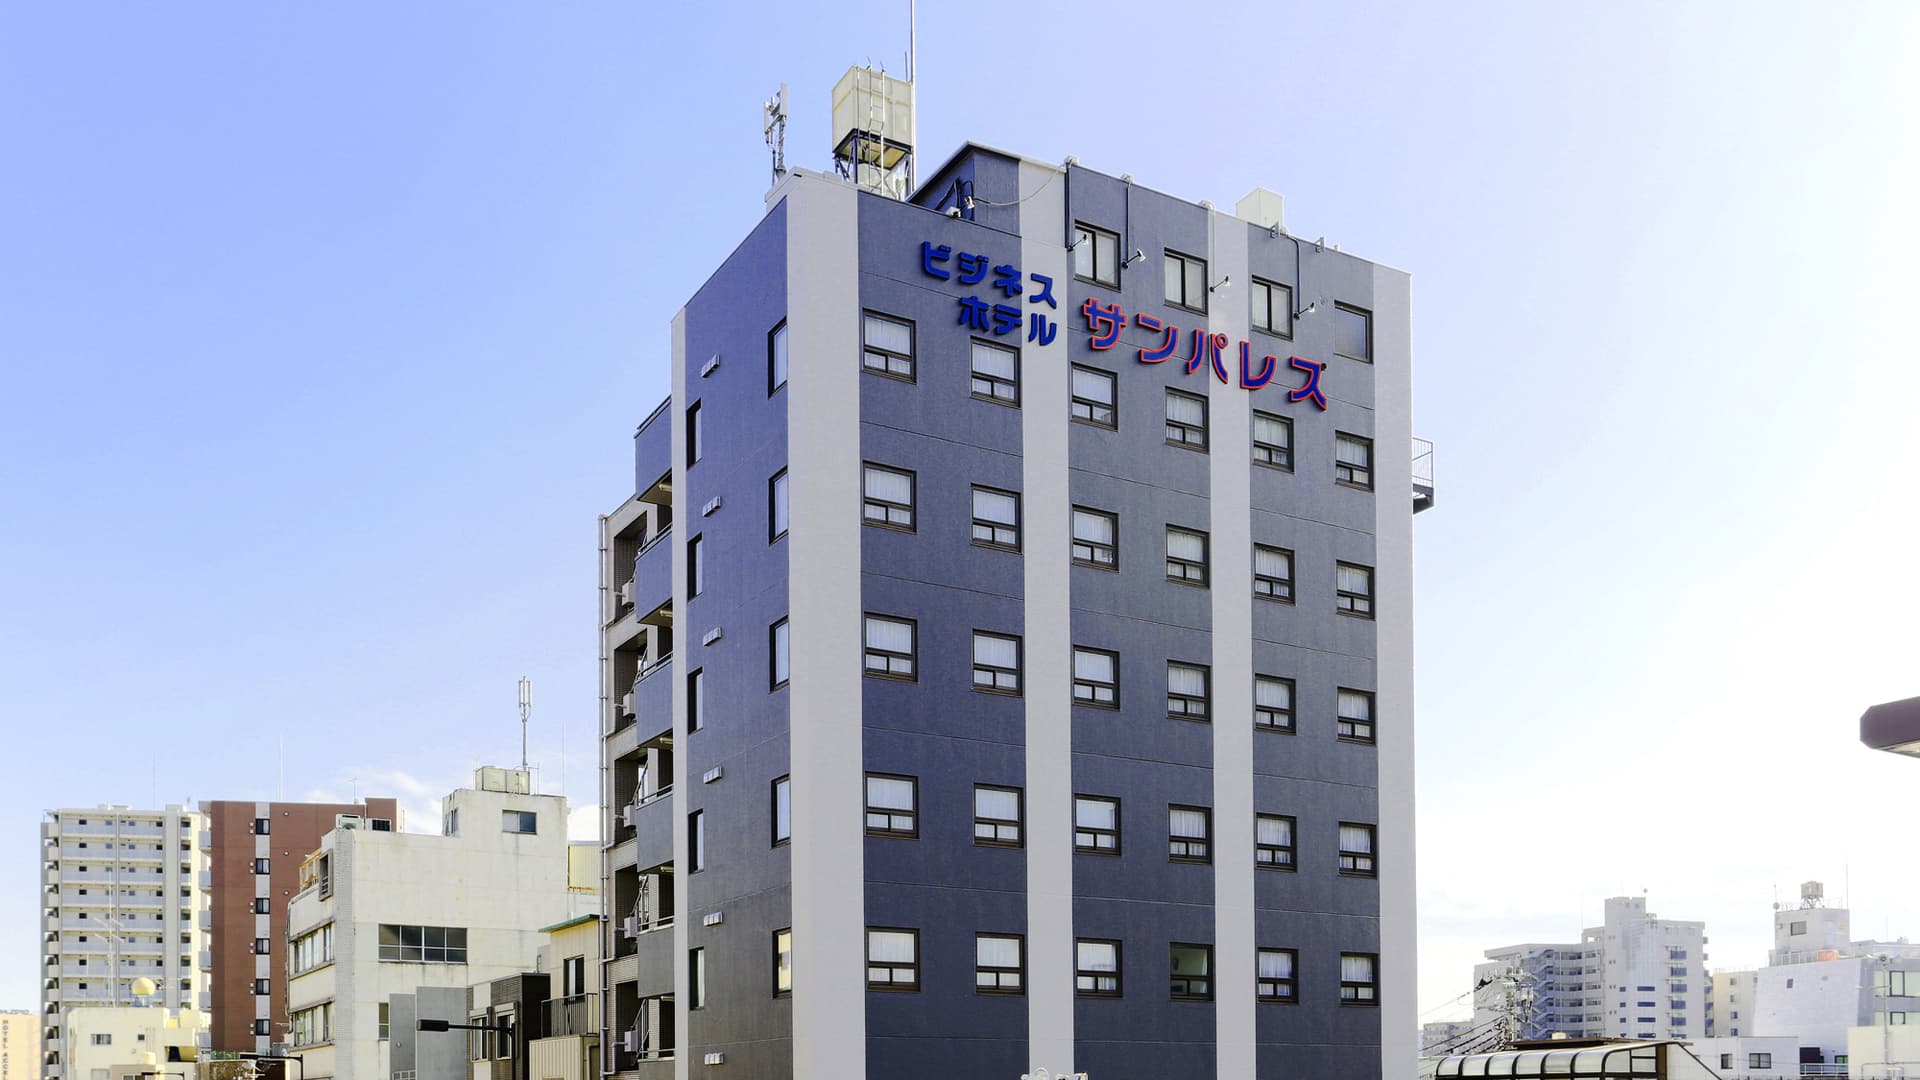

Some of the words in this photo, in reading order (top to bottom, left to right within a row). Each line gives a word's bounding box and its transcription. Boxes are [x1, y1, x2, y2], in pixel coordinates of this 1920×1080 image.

[921, 241, 1057, 309] ビジネス
[959, 296, 1057, 346] ホテル
[1083, 297, 1327, 410] サンパレス
